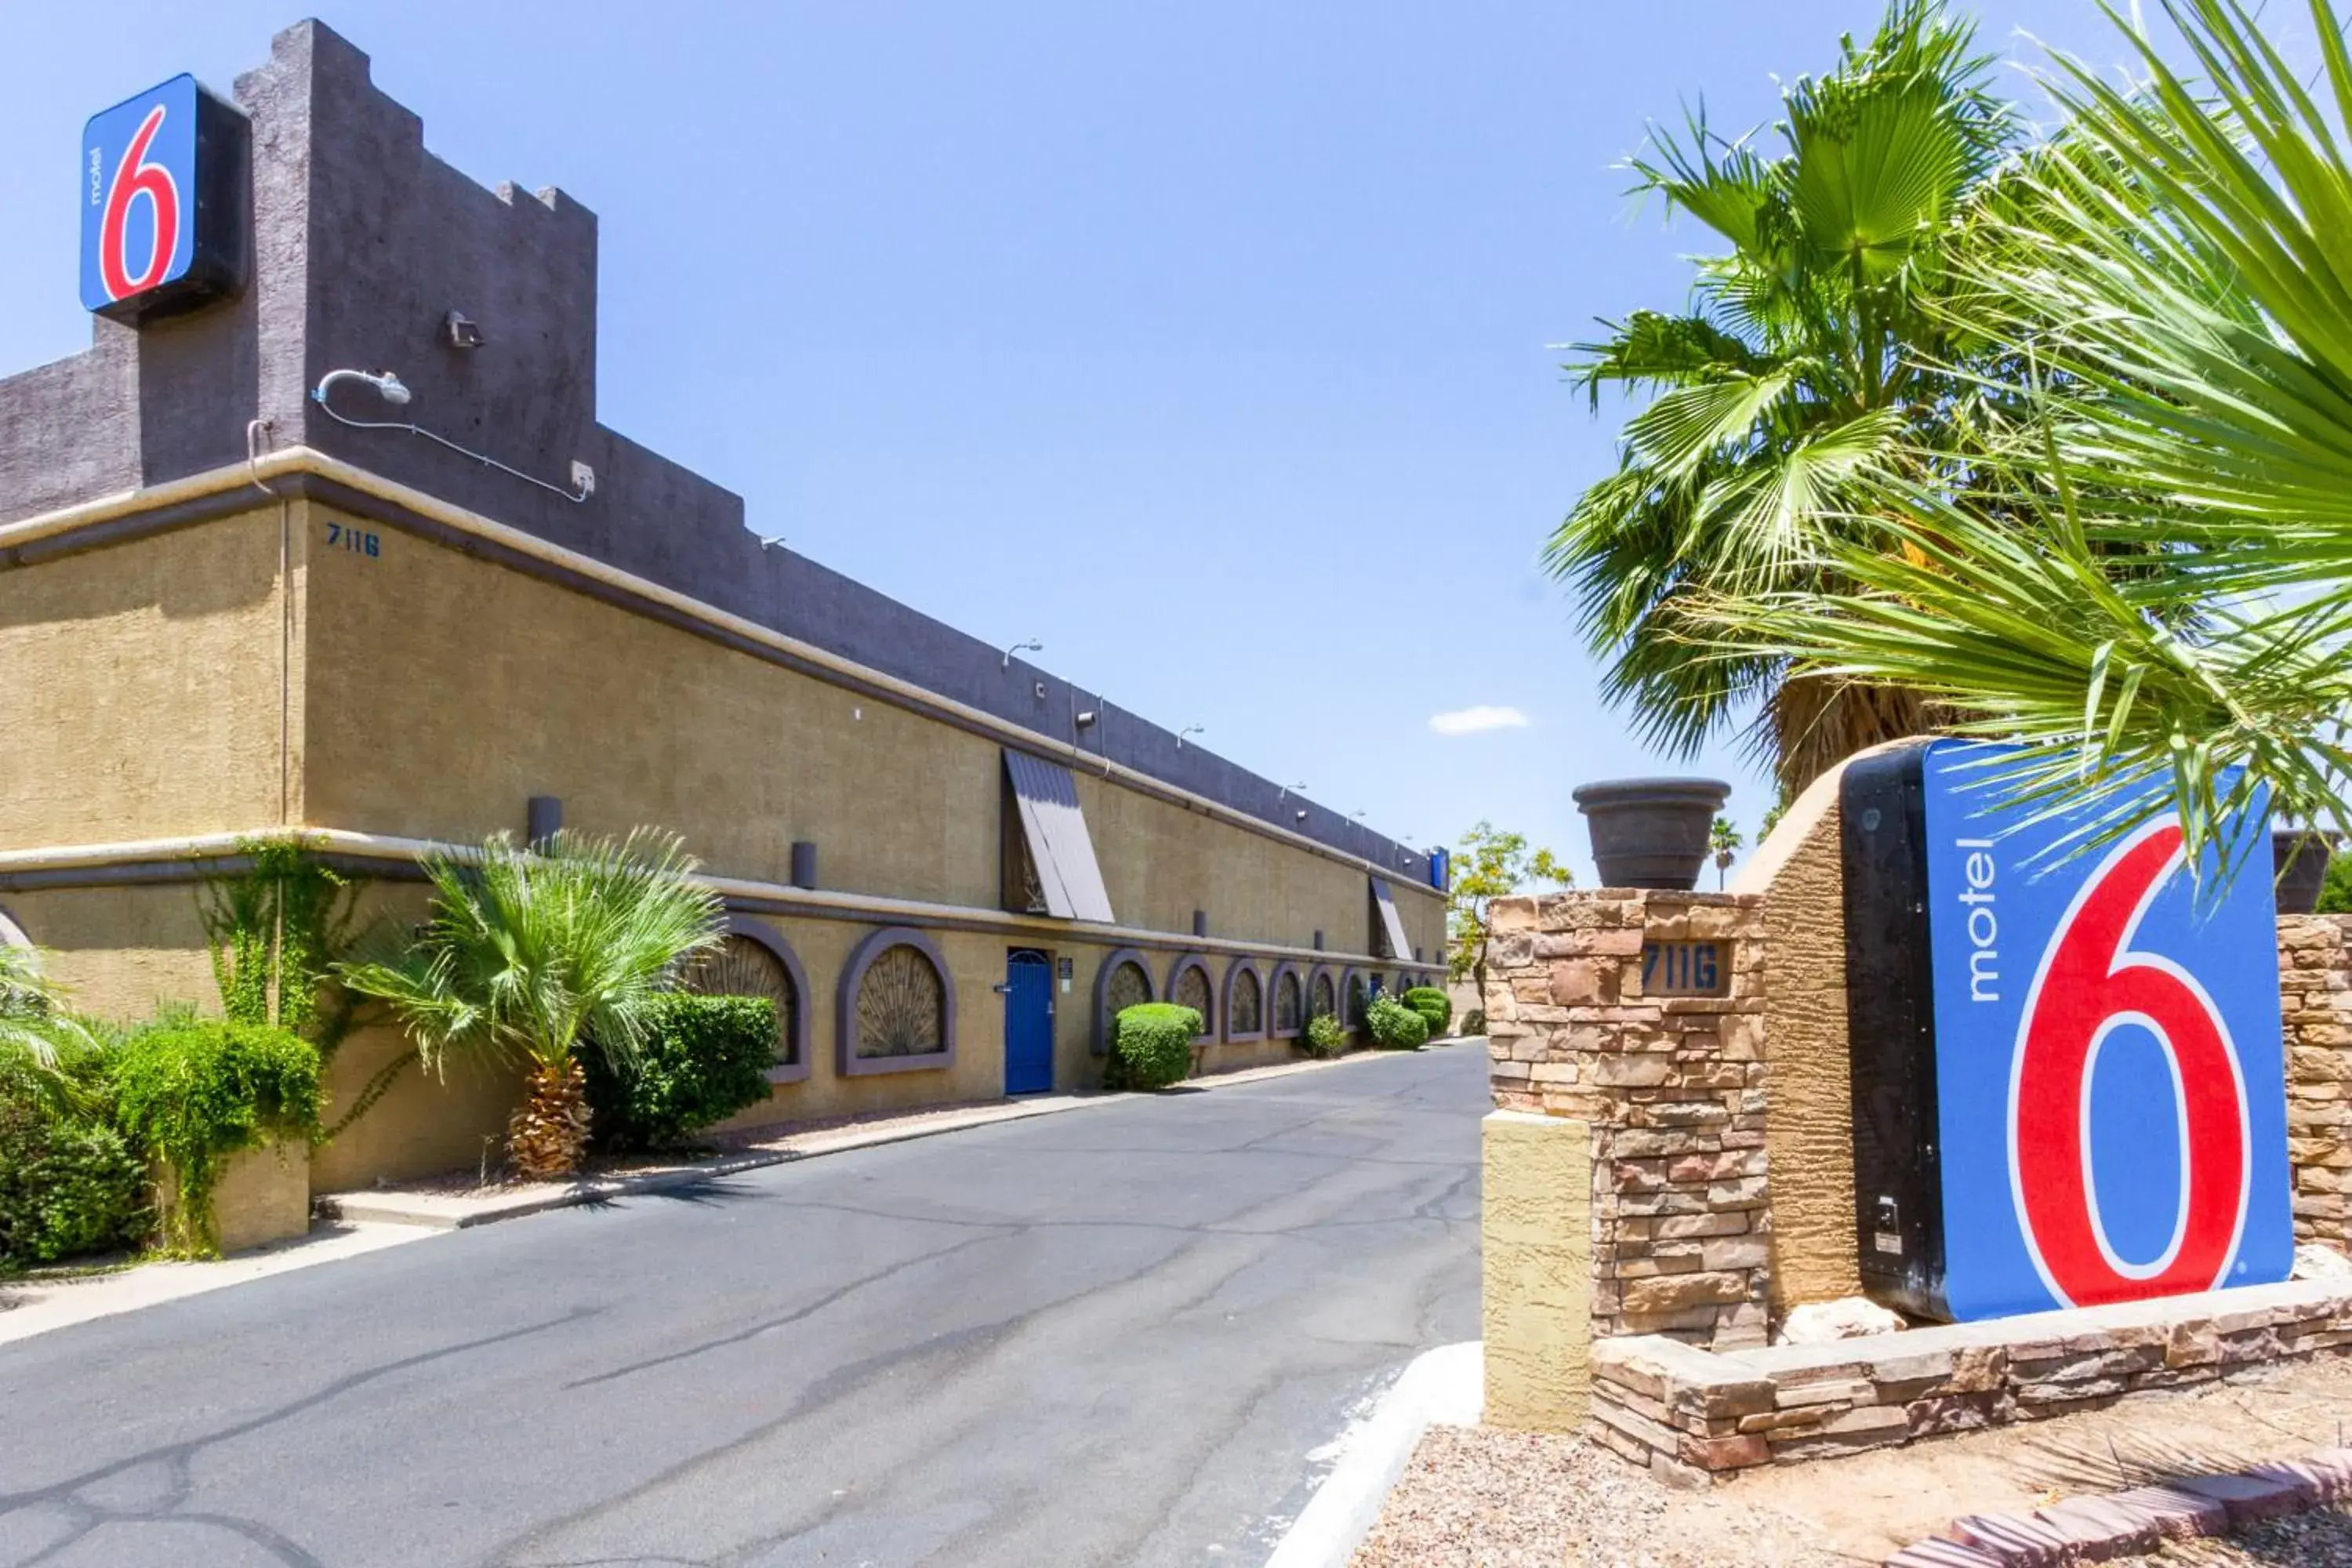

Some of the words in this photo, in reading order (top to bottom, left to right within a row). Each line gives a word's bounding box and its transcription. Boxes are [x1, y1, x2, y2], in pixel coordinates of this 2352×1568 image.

[89, 147, 101, 205] motel
[99, 103, 180, 301] 6
[326, 522, 379, 557] 7116
[1642, 944, 1717, 989] 7116
[1956, 838, 1999, 1002] motel
[2006, 811, 2252, 1308] 6
